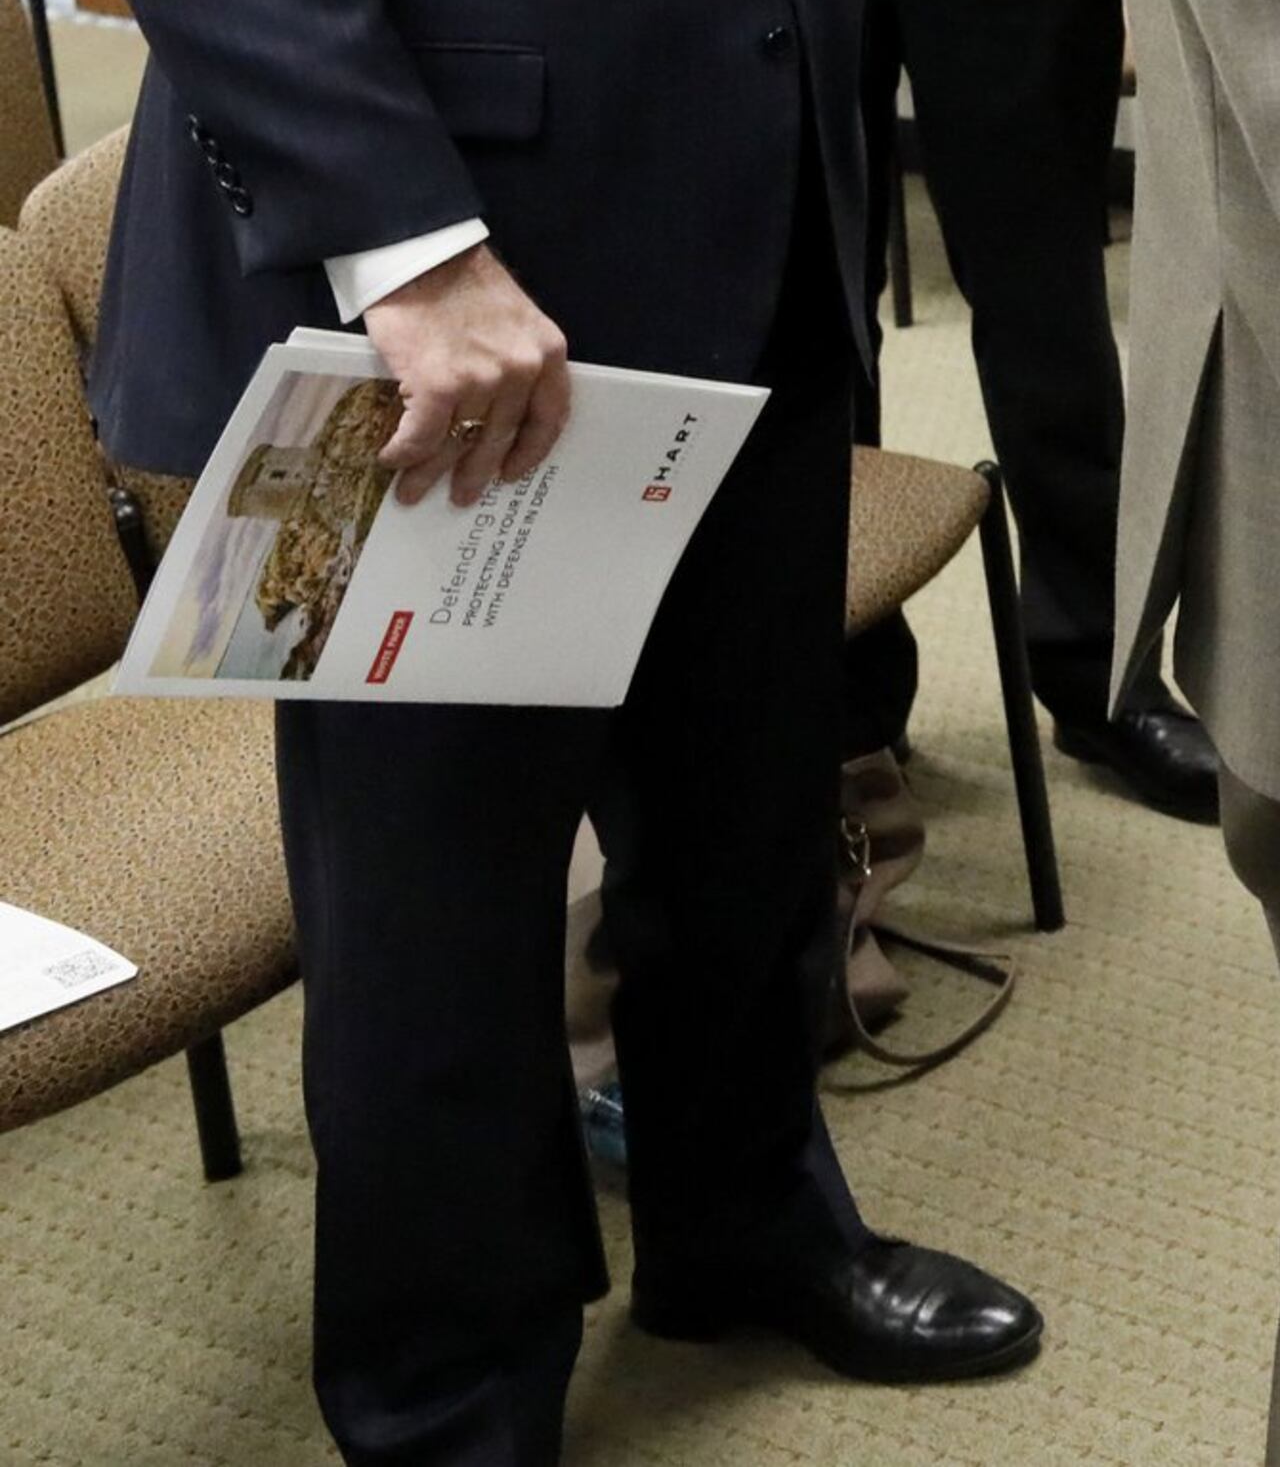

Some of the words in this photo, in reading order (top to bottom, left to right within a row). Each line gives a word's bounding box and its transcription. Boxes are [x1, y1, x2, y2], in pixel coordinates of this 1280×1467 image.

[653, 413, 698, 481] HART
[530, 465, 560, 506] DEPTH
[523, 509, 540, 525] IN
[429, 512, 496, 624] Defending
[462, 540, 505, 627] PROTECTING
[497, 500, 521, 536] YOUR
[496, 528, 531, 589] DEFENSE
[482, 591, 506, 628] WITH
